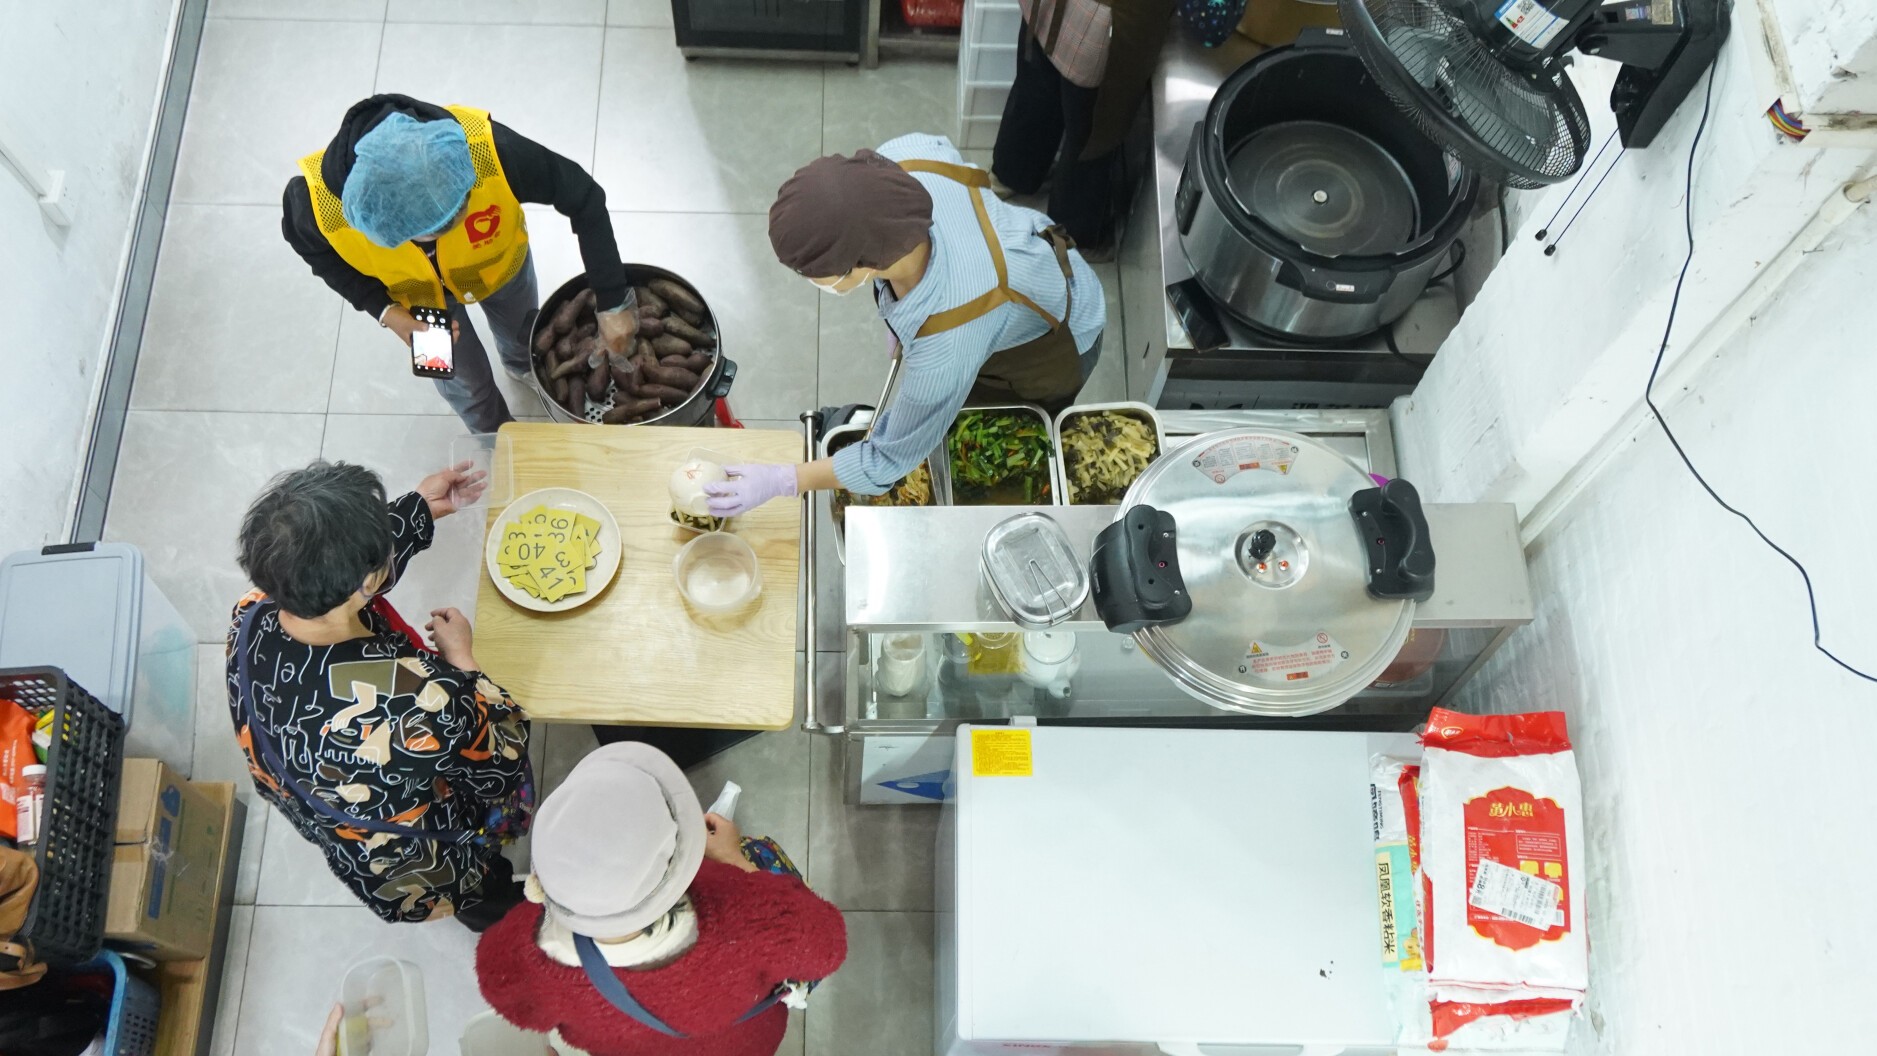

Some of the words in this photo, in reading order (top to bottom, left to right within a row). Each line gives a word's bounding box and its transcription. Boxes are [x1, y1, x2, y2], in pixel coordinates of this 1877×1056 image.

[518, 542, 546, 560] 40
[540, 567, 564, 590] 41
[1378, 862, 1395, 954] 凤凰软香粘米
